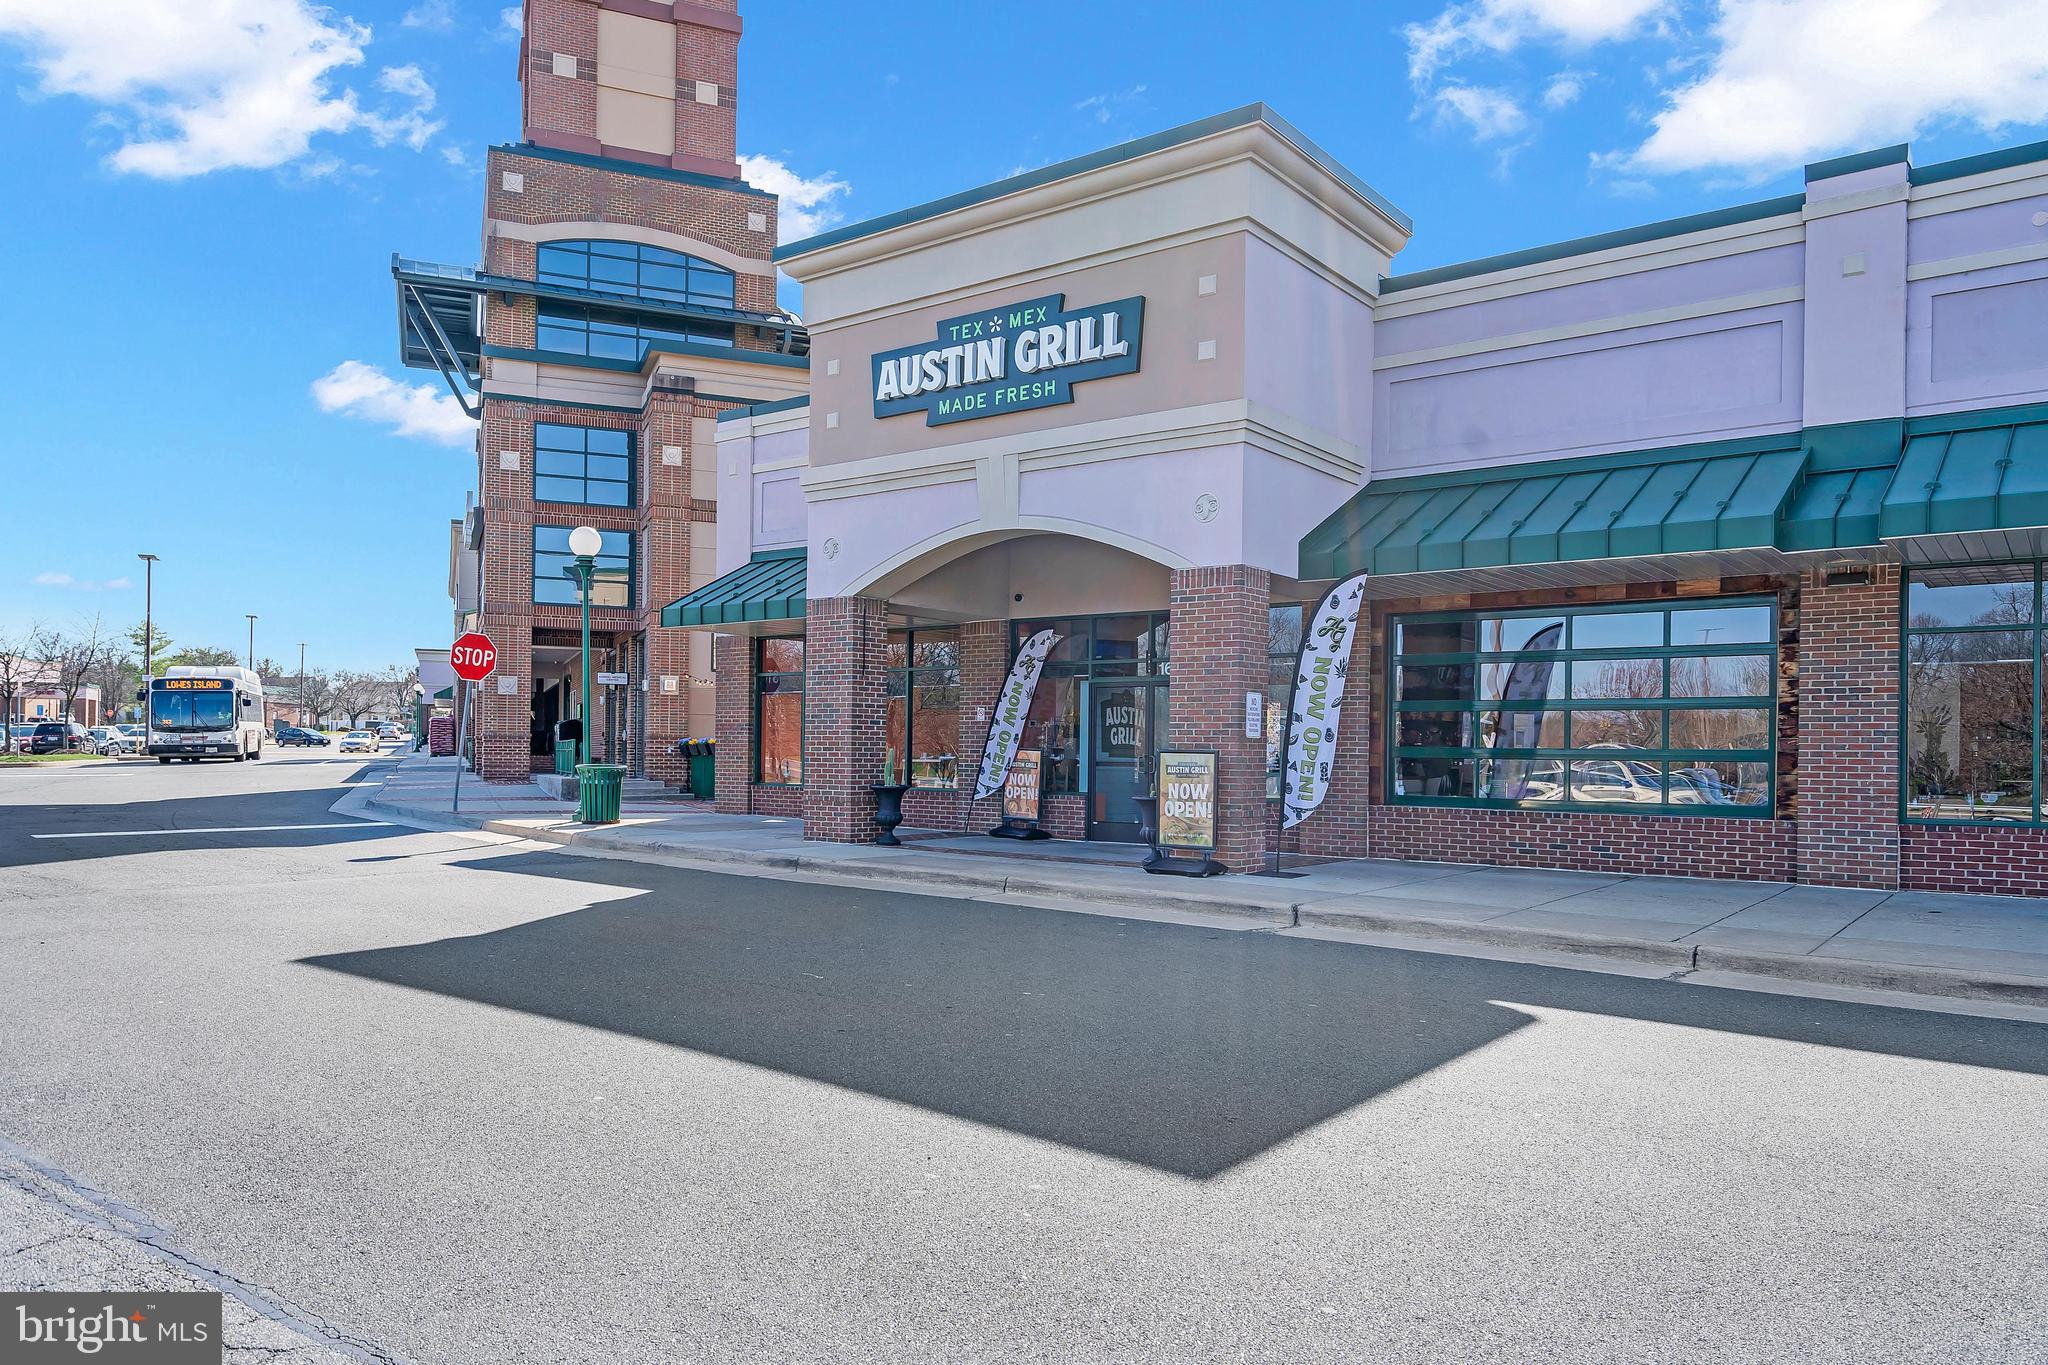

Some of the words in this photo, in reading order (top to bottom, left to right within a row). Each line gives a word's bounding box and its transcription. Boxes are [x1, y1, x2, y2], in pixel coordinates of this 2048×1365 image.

[950, 320, 983, 341] TEX
[1009, 306, 1047, 329] MEX
[876, 336, 1006, 401] AUSTIN
[1014, 311, 1129, 374] GRILL
[939, 392, 987, 415] MADE
[995, 380, 1056, 404] FRESH
[453, 646, 494, 667] STOP
[166, 681, 191, 689] LOWES
[193, 681, 222, 689] ISLAND
[1306, 656, 1333, 721] NOW
[1003, 680, 1024, 728] NOW
[1105, 705, 1146, 729] AUSTIN
[1110, 726, 1141, 747] GRILL
[988, 730, 1012, 783] OPEN!
[1297, 727, 1322, 801] OPEN!
[1009, 772, 1037, 785] NOW
[1167, 766, 1190, 774] AUSTIN
[1190, 766, 1209, 774] GRILL
[1006, 786, 1038, 800] OPEN!
[1168, 782, 1209, 800] NOW
[1164, 800, 1212, 818] OPEN!
